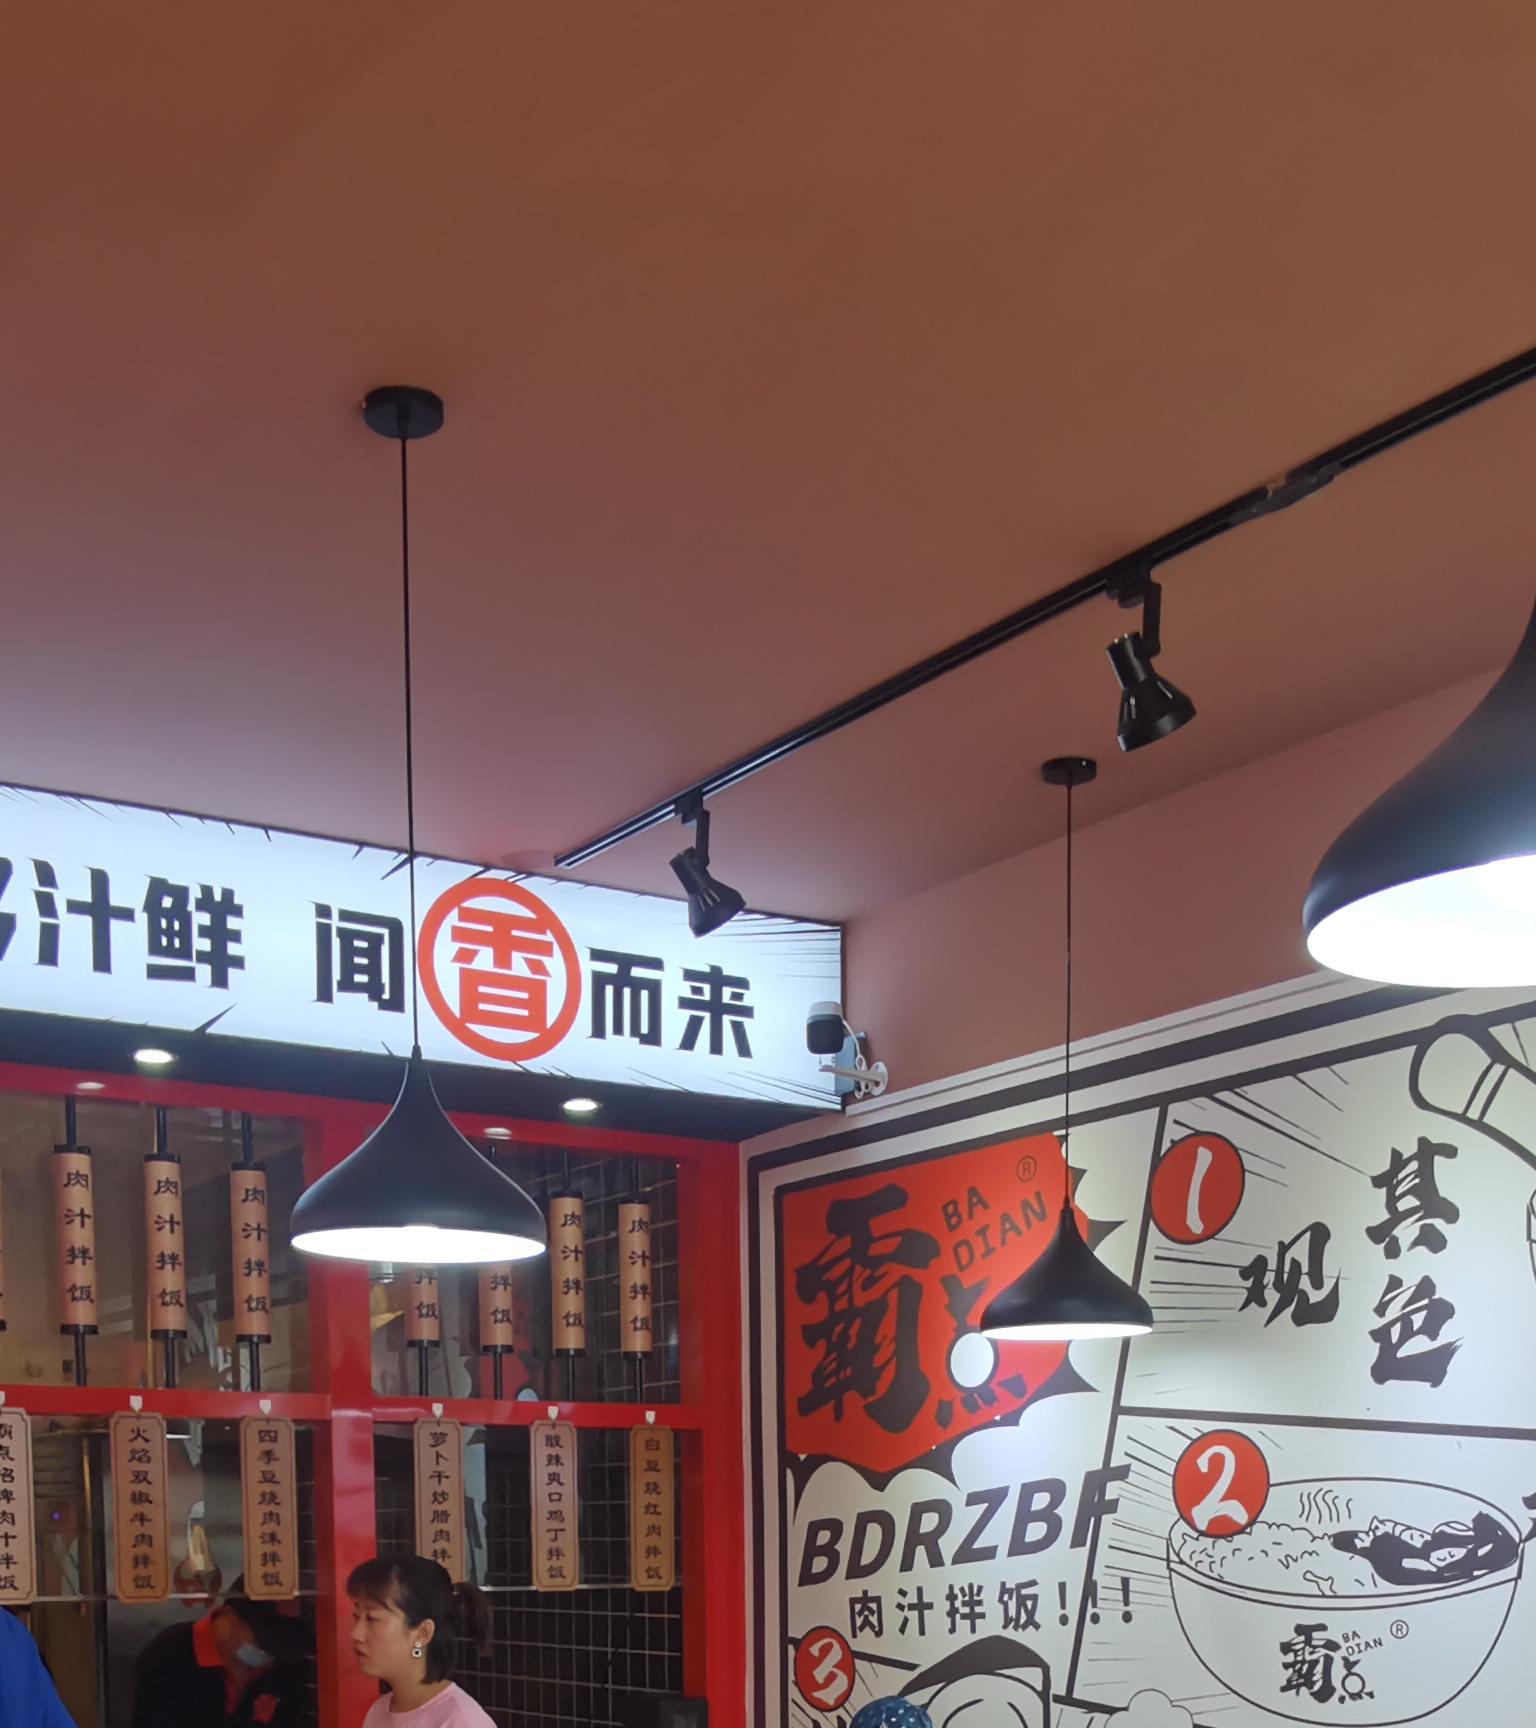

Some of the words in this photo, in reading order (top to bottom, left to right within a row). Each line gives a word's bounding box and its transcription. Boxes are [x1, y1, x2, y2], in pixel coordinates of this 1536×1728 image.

[311, 901, 754, 1058] 闻香而来
[63, 1169, 95, 1305] 肉汁拌饭
[153, 1177, 185, 1309] 肉汁拌饭
[240, 1185, 270, 1315] 肉汁拌饭
[942, 1186, 990, 1232] BA
[952, 1190, 1048, 1272] DIAN
[1187, 1147, 1215, 1235] 1
[560, 1210, 584, 1330] 肉汁拌饭
[627, 1217, 652, 1333] 肉汁拌饭
[127, 1426, 156, 1590] 火焰双椒牛肉拌饭
[429, 1432, 452, 1562] 萝卜干炒腊肉拌
[545, 1434, 566, 1580] 酸辣爽口鸡丁拌饭
[798, 1464, 1132, 1587] BDRZBF
[1196, 1444, 1248, 1530] 2
[808, 1635, 849, 1705] 3
[1279, 1622, 1375, 1704] 霸点
[1342, 1630, 1361, 1643] BA
[1345, 1637, 1384, 1657] DIAN
